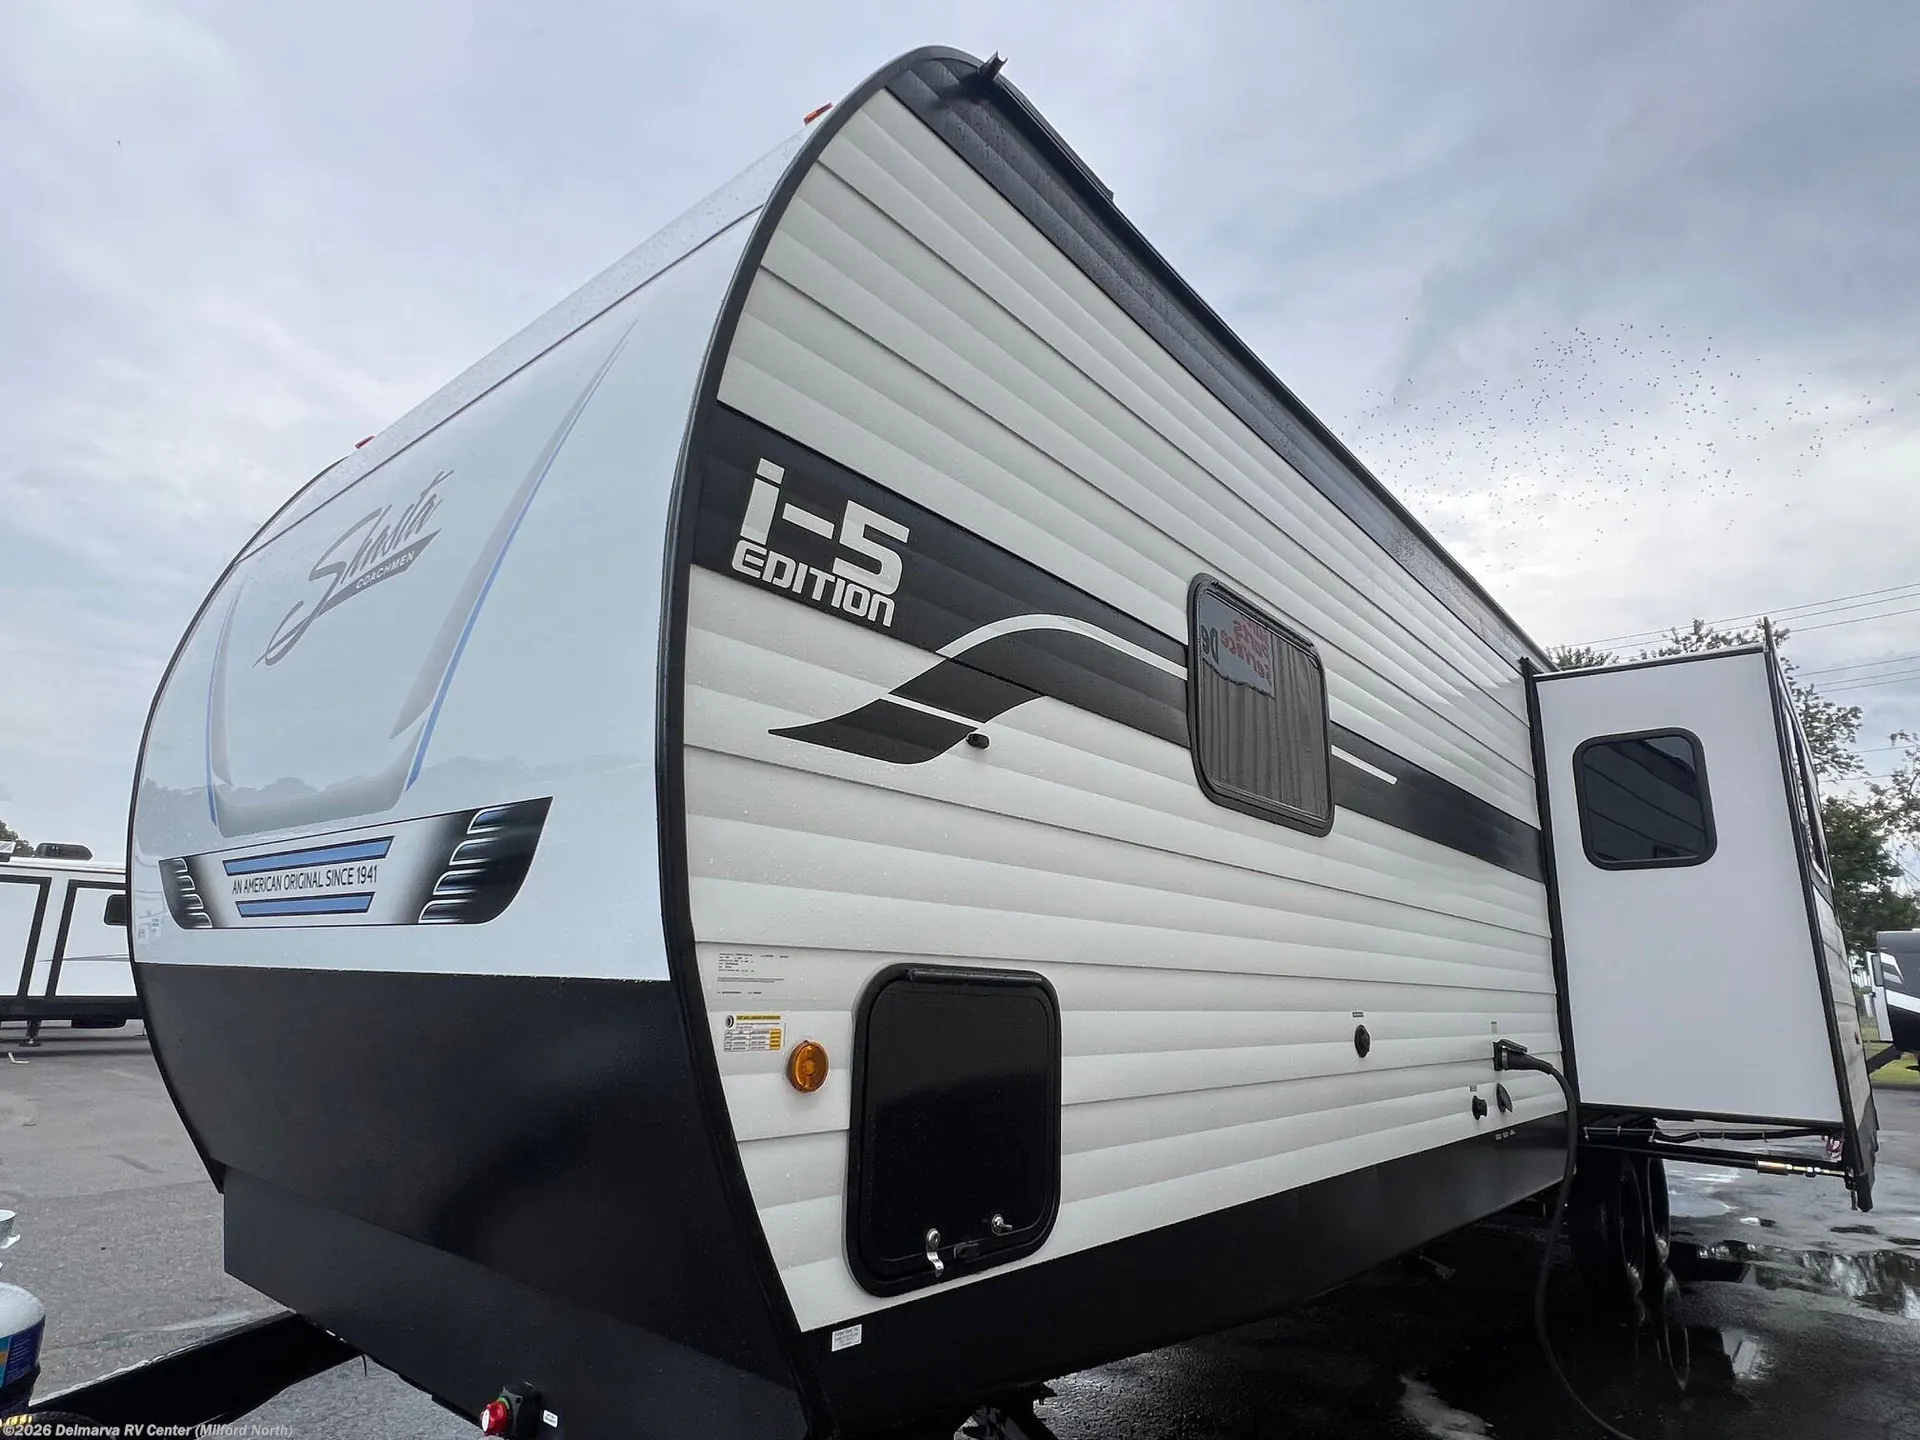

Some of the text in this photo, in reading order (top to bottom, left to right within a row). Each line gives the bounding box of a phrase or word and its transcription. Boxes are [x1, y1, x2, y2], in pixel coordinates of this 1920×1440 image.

[356, 550, 416, 589] COACHMEN
[232, 864, 378, 895] AN AMERICAN ORIGINAL SINCE 1941
